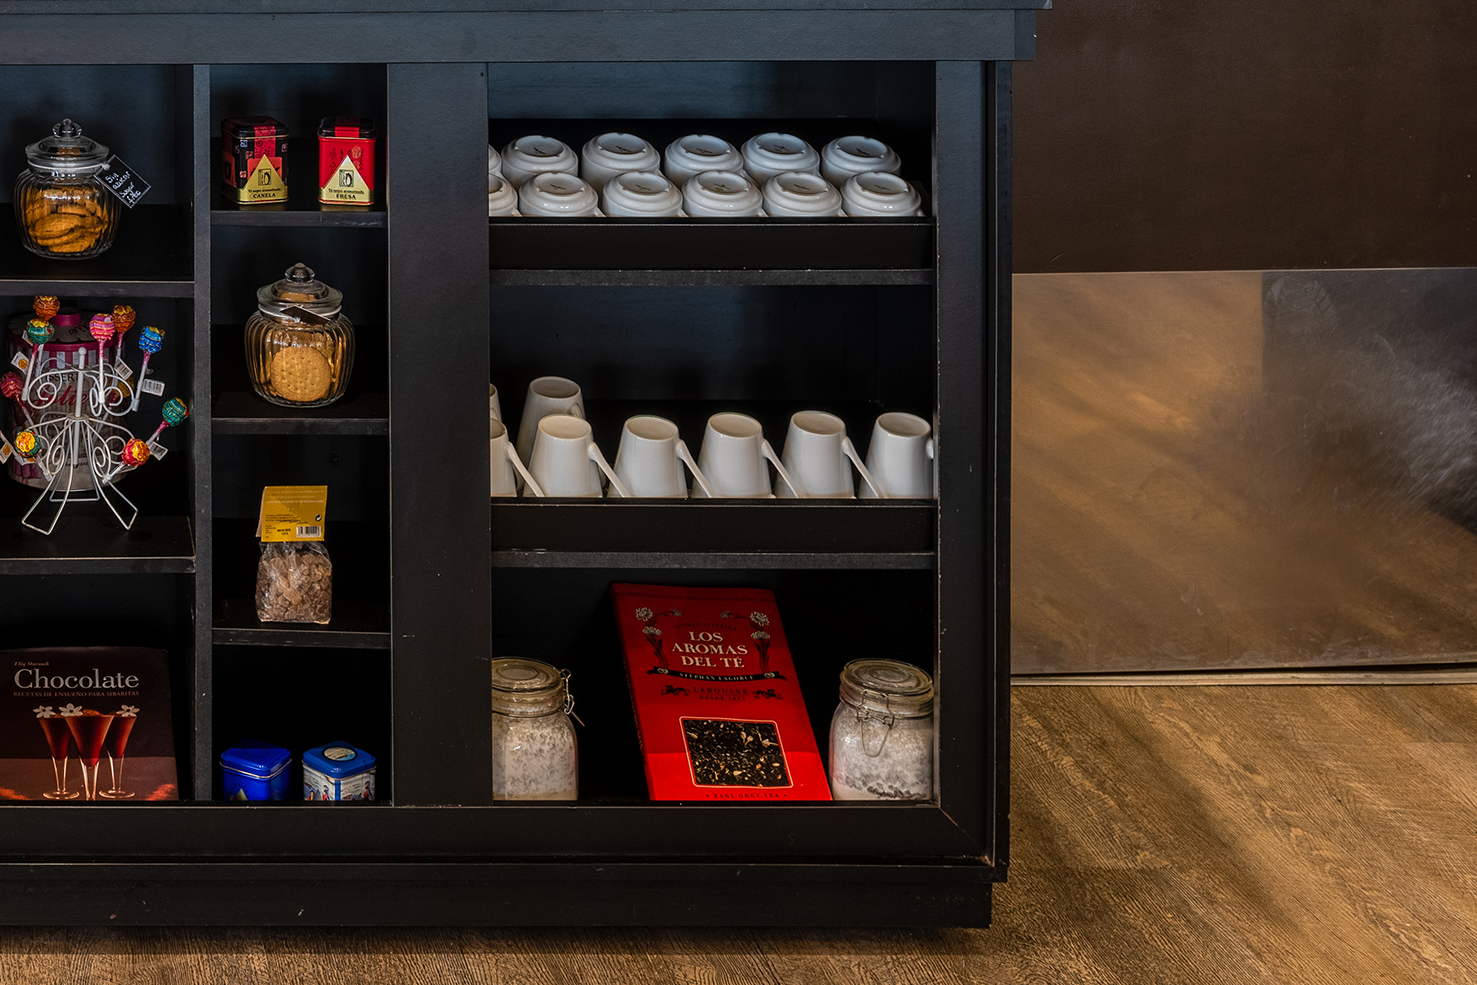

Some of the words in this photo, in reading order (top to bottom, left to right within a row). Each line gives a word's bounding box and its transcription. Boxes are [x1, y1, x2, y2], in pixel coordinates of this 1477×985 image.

[688, 631, 723, 642] LOS
[672, 643, 748, 655] AROMAS
[681, 655, 717, 667] DEL
[719, 655, 745, 668] TÉ
[14, 668, 140, 689] Chocolate
[693, 686, 749, 694] LAROUSSE
